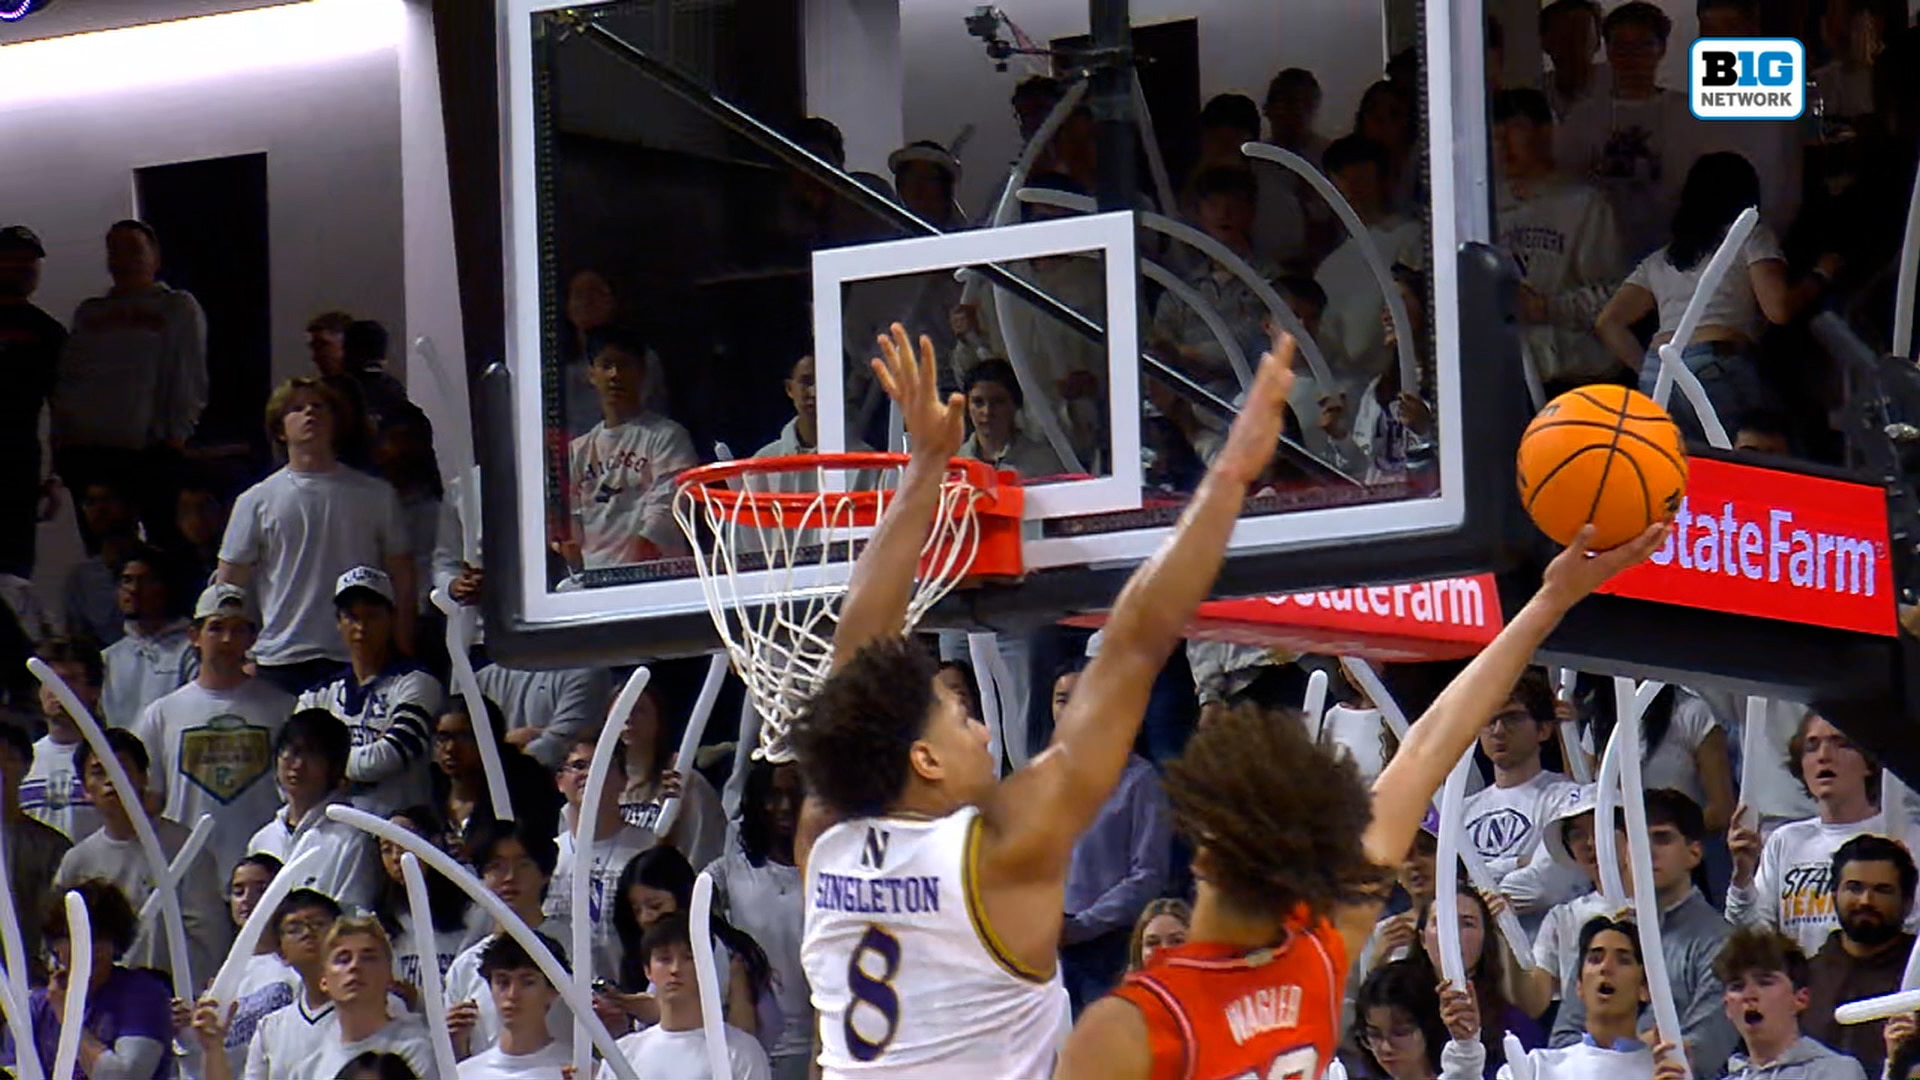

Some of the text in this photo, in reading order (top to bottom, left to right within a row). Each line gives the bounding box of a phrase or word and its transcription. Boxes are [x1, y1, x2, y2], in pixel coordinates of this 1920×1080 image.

[1294, 578, 1484, 627] aeFarm
[861, 826, 890, 869] N
[815, 872, 940, 914] SINGLETON
[1782, 867, 1834, 899] STA
[844, 921, 901, 1062] 8
